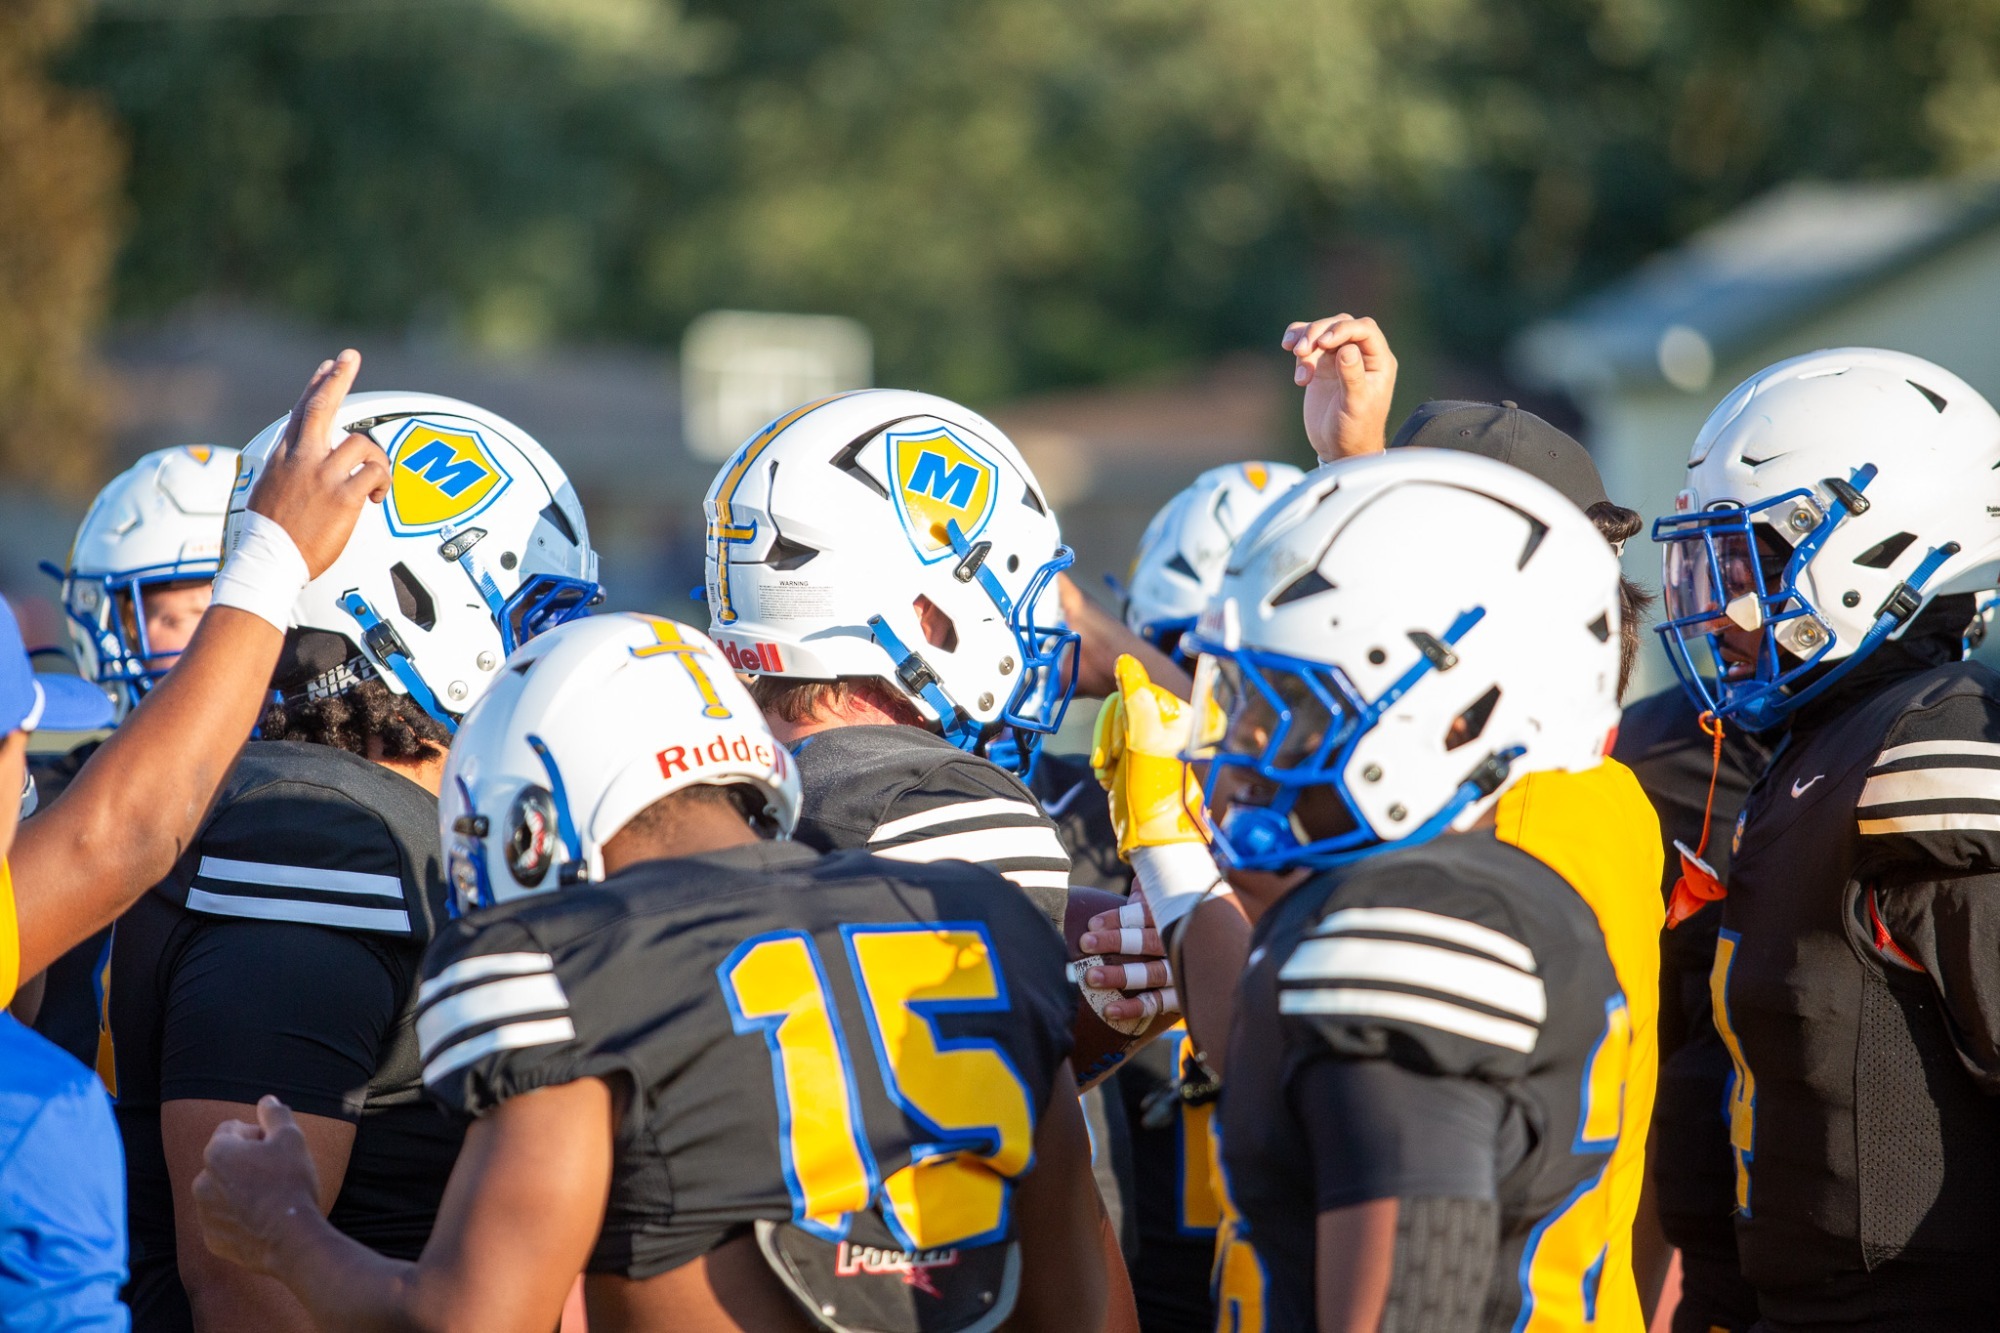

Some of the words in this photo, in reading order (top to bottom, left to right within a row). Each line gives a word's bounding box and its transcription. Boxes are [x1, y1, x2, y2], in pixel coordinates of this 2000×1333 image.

[400, 439, 489, 499] M
[905, 449, 982, 511] M
[714, 637, 785, 673] dell
[656, 734, 787, 780] Riddell
[716, 921, 1037, 1252] 15
